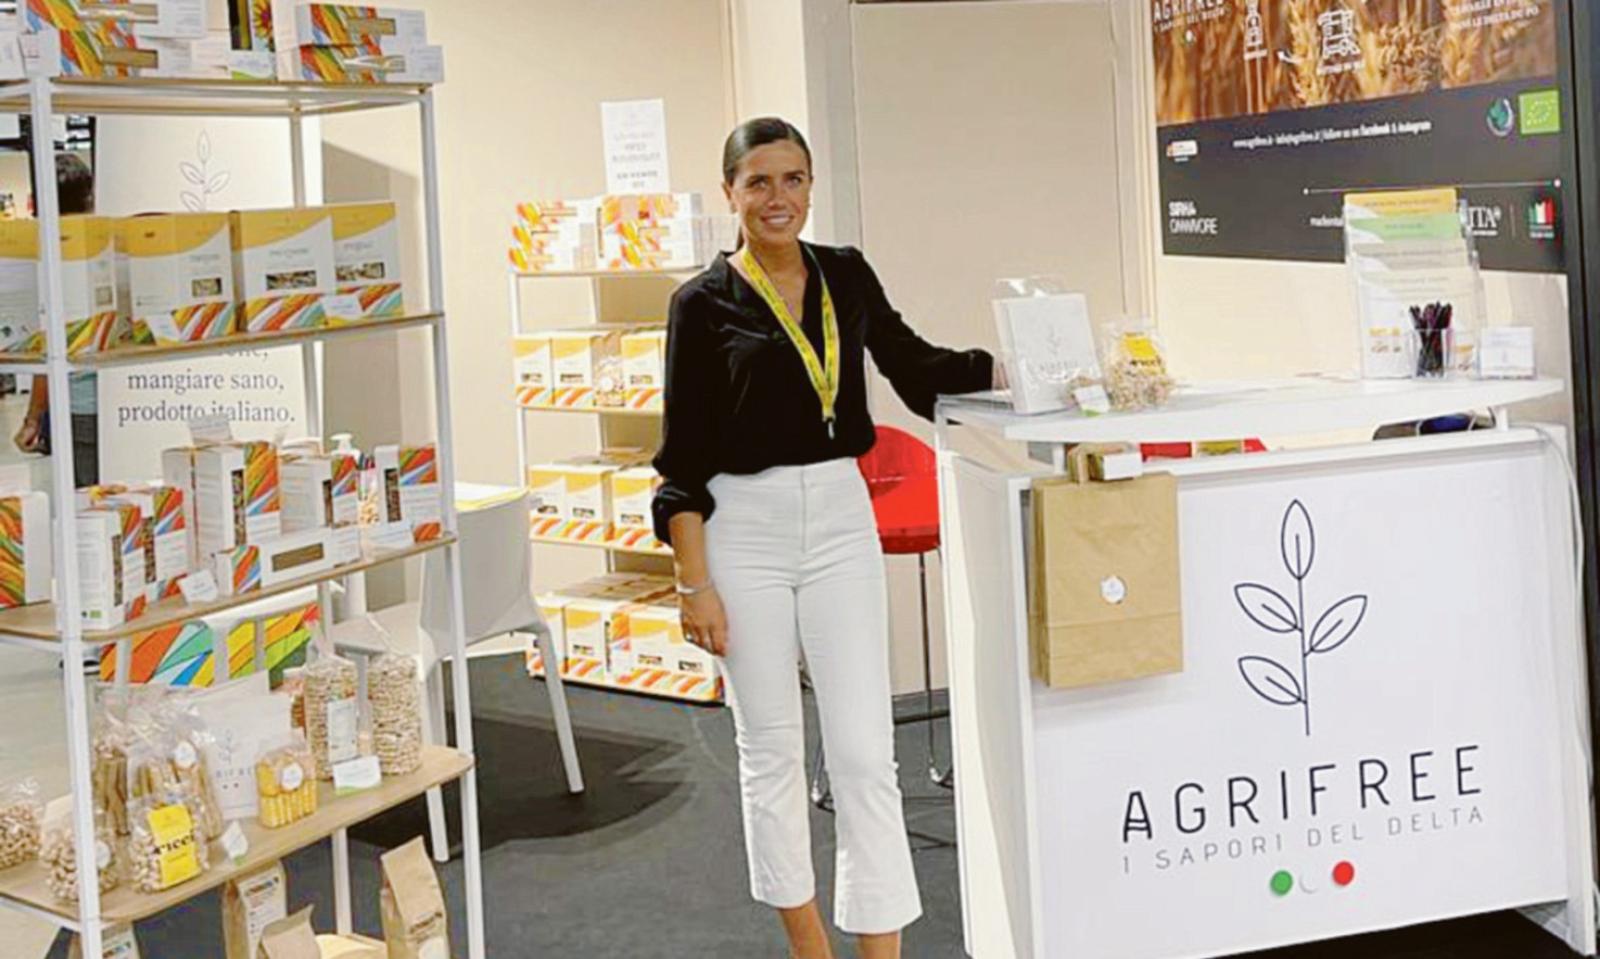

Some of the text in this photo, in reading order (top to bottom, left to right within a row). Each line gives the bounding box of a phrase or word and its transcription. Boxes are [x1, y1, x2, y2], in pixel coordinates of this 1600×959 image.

[127, 368, 285, 396] mangiare sano,
[117, 400, 296, 428] prodotto italiano.
[1123, 745, 1482, 844] AGRIFREE
[1154, 833, 1283, 870] SAPORI
[1307, 824, 1364, 848] DEL
[1387, 805, 1483, 836] DELTA
